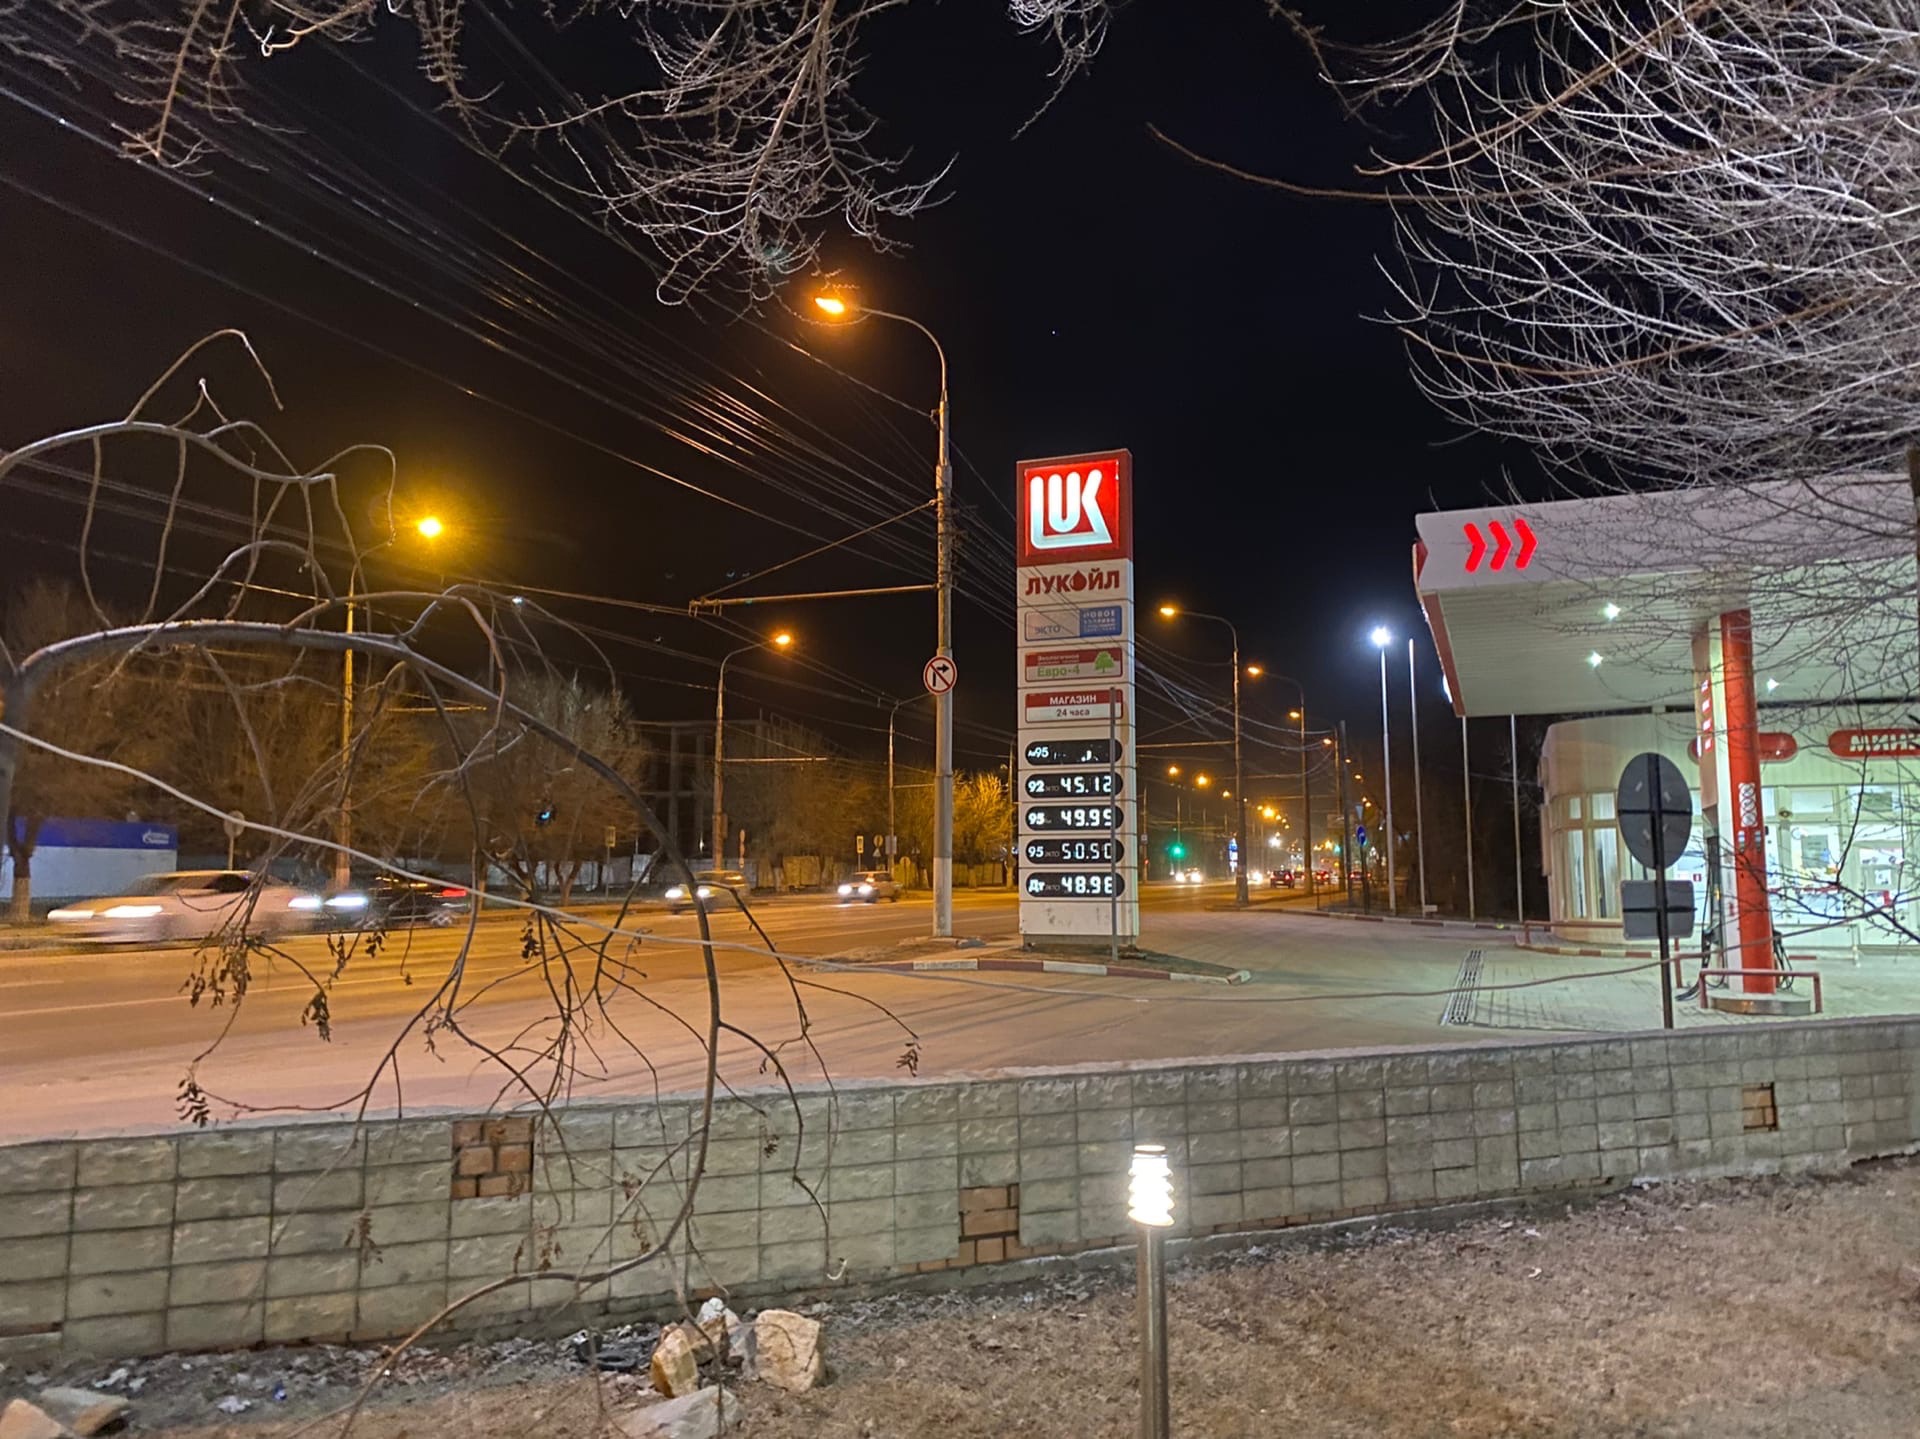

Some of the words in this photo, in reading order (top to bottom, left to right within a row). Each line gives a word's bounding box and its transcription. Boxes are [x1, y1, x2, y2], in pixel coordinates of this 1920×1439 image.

[1025, 568, 1120, 595] ЛУКОЙЛ
[1037, 664, 1080, 679] Евро-4
[1049, 695, 1097, 705] МАГАЗИН
[1056, 708, 1067, 717] 24
[1070, 708, 1090, 716] часа
[1028, 780, 1045, 793] 92
[1060, 776, 1112, 793] 45.12
[1028, 812, 1045, 825] 95
[1028, 846, 1044, 857] 95
